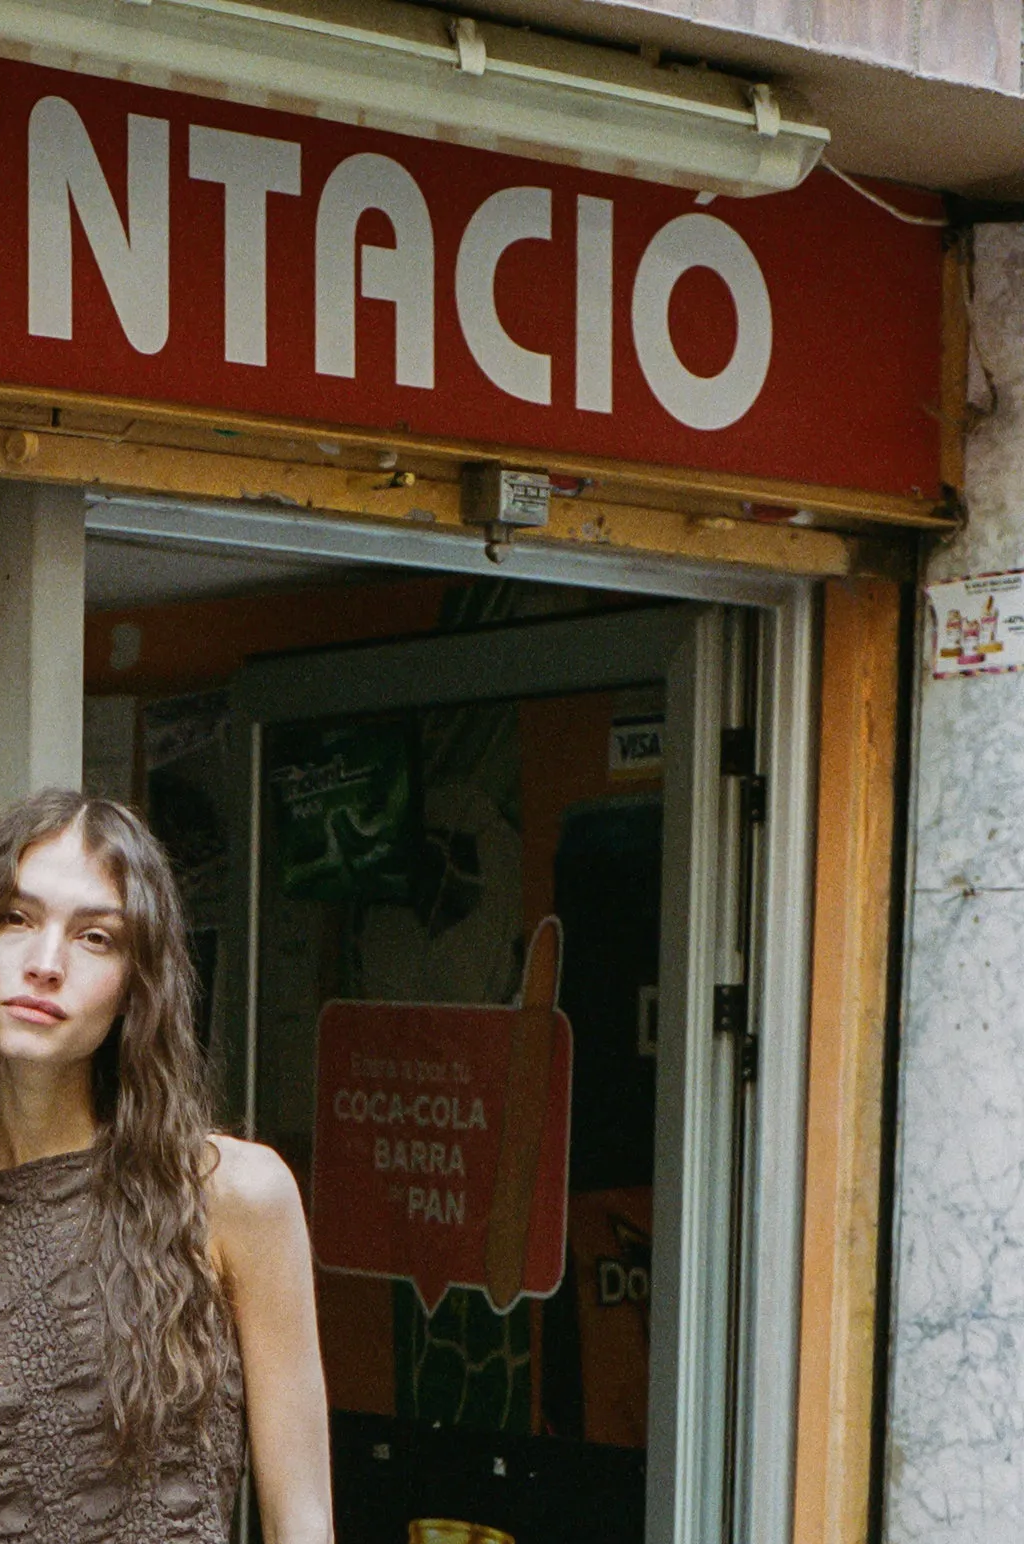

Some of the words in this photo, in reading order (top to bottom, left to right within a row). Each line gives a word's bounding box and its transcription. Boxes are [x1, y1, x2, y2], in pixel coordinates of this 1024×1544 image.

[617, 732, 661, 757] VISA
[333, 1089, 487, 1131] COCA-COLA
[376, 1140, 466, 1177] BARRA
[408, 1189, 466, 1225] PAN
